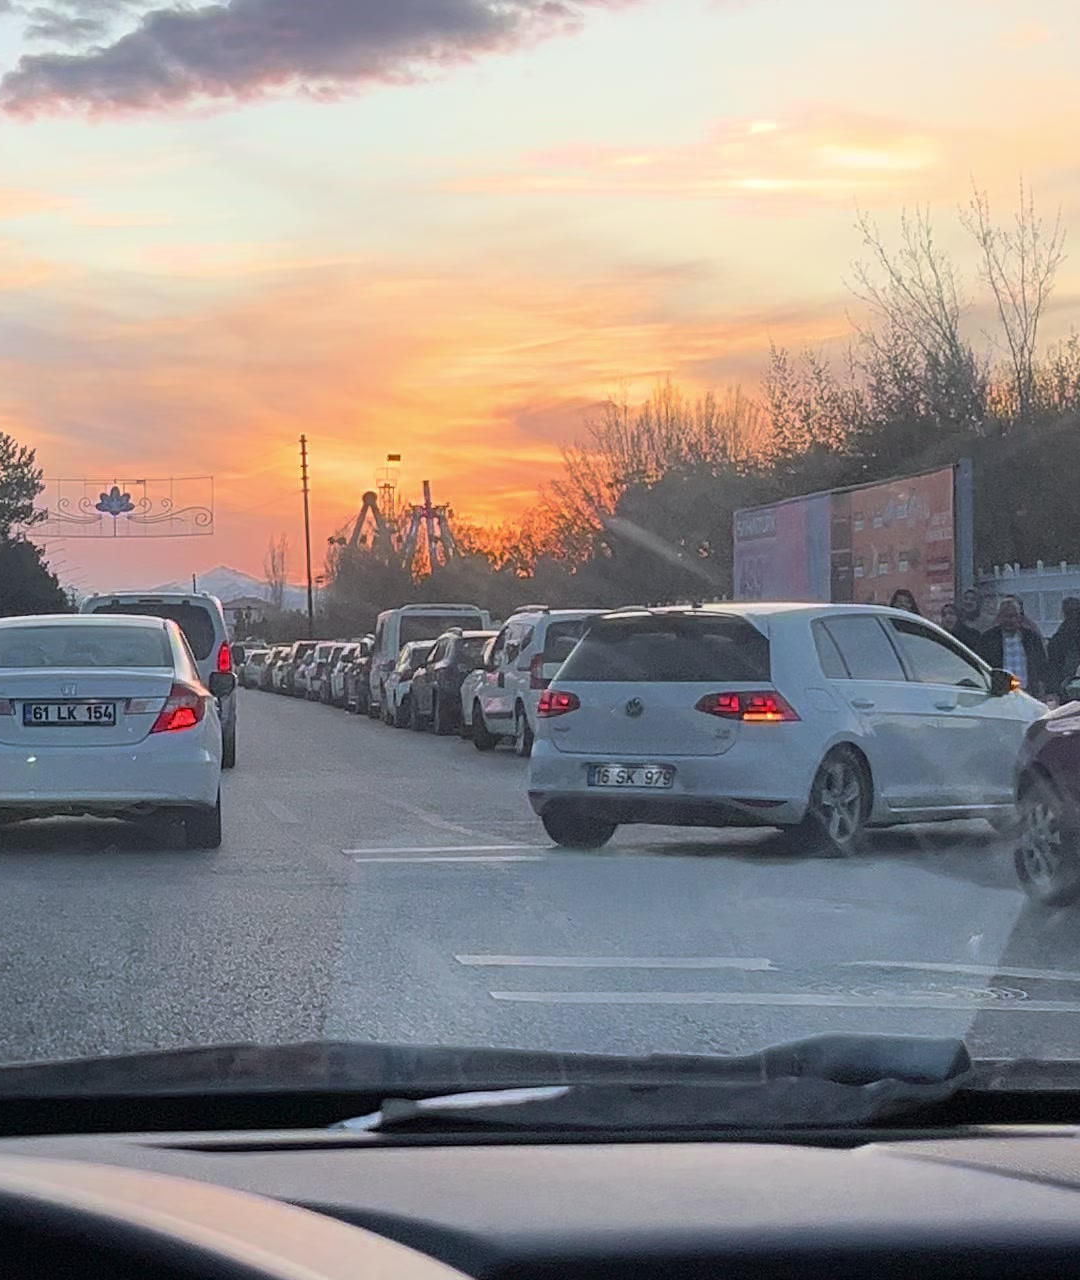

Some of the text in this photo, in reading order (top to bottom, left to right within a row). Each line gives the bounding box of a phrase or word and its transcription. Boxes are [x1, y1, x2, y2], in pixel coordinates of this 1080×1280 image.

[33, 706, 112, 720] 61 LK 154
[596, 769, 671, 786] 16 SK 979
